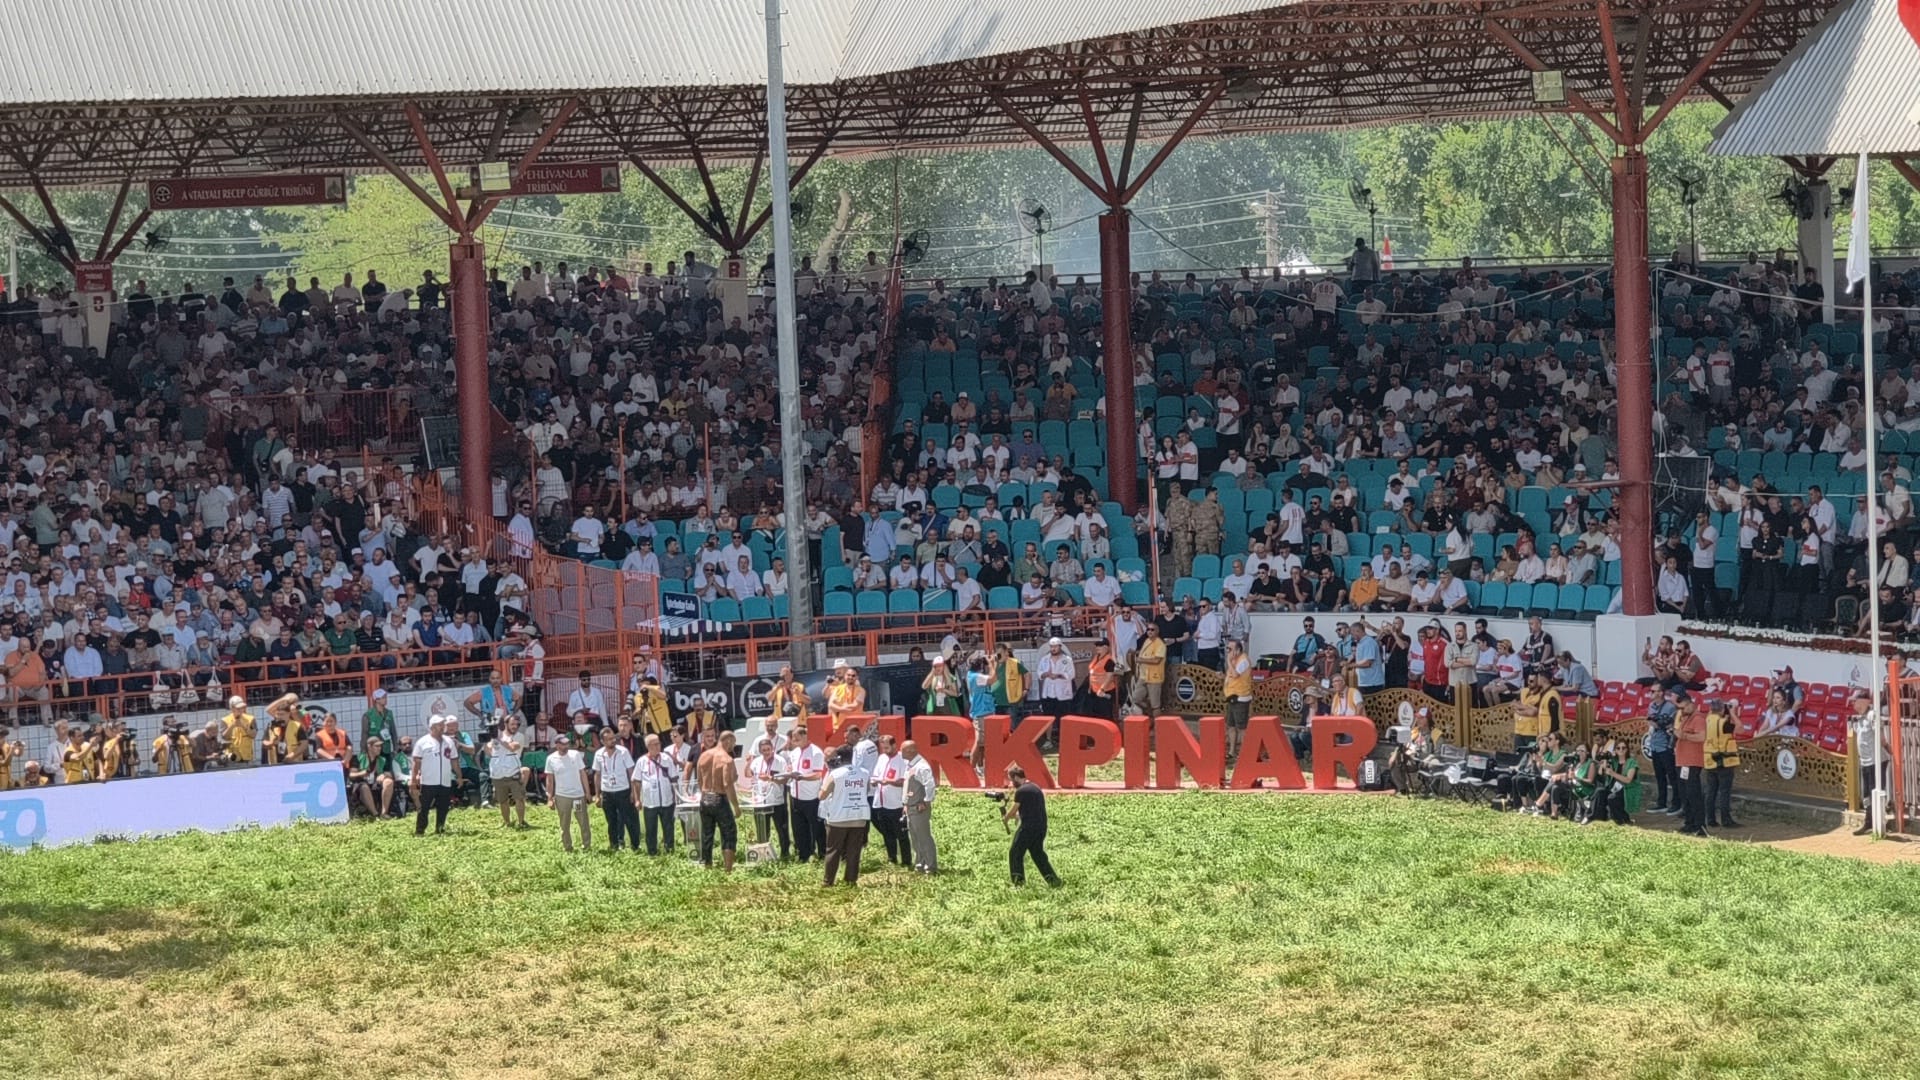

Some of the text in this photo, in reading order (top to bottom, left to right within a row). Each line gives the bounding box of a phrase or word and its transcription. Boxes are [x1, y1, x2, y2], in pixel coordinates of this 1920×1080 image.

[222, 188, 245, 199] RECEP
[247, 184, 279, 198] GÜRBÜZ
[526, 180, 567, 193] TRİBÜNÜ
[729, 261, 740, 278] B
[748, 697, 766, 709] No.
